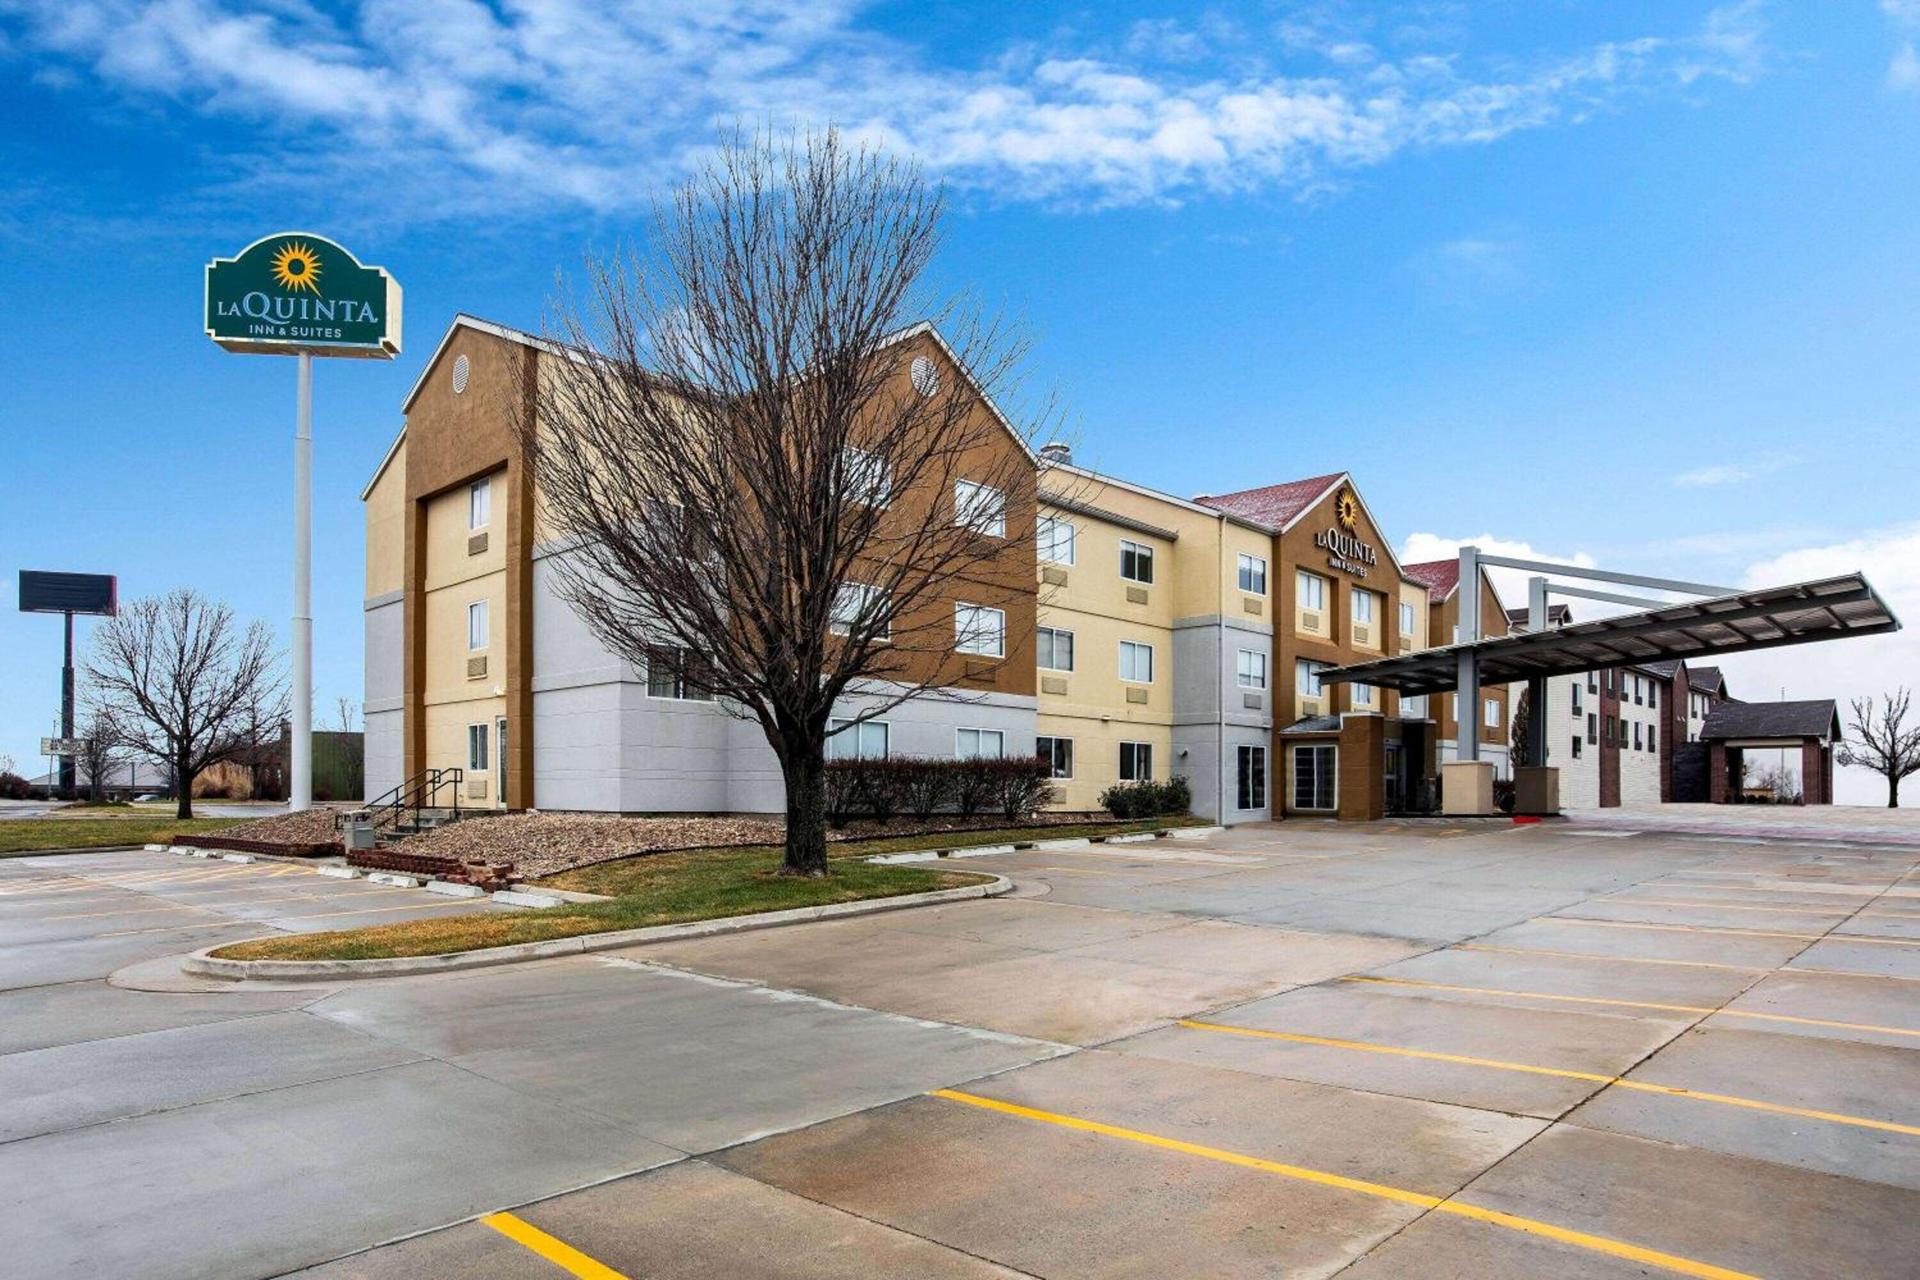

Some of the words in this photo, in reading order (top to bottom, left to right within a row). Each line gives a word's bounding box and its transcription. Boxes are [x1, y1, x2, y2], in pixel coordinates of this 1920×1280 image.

[217, 301, 242, 317] LA
[242, 291, 379, 325] QUINTA
[249, 324, 275, 336] INN
[278, 327, 287, 336] &
[290, 326, 342, 338] SUITES
[1328, 528, 1377, 566] QUINTA
